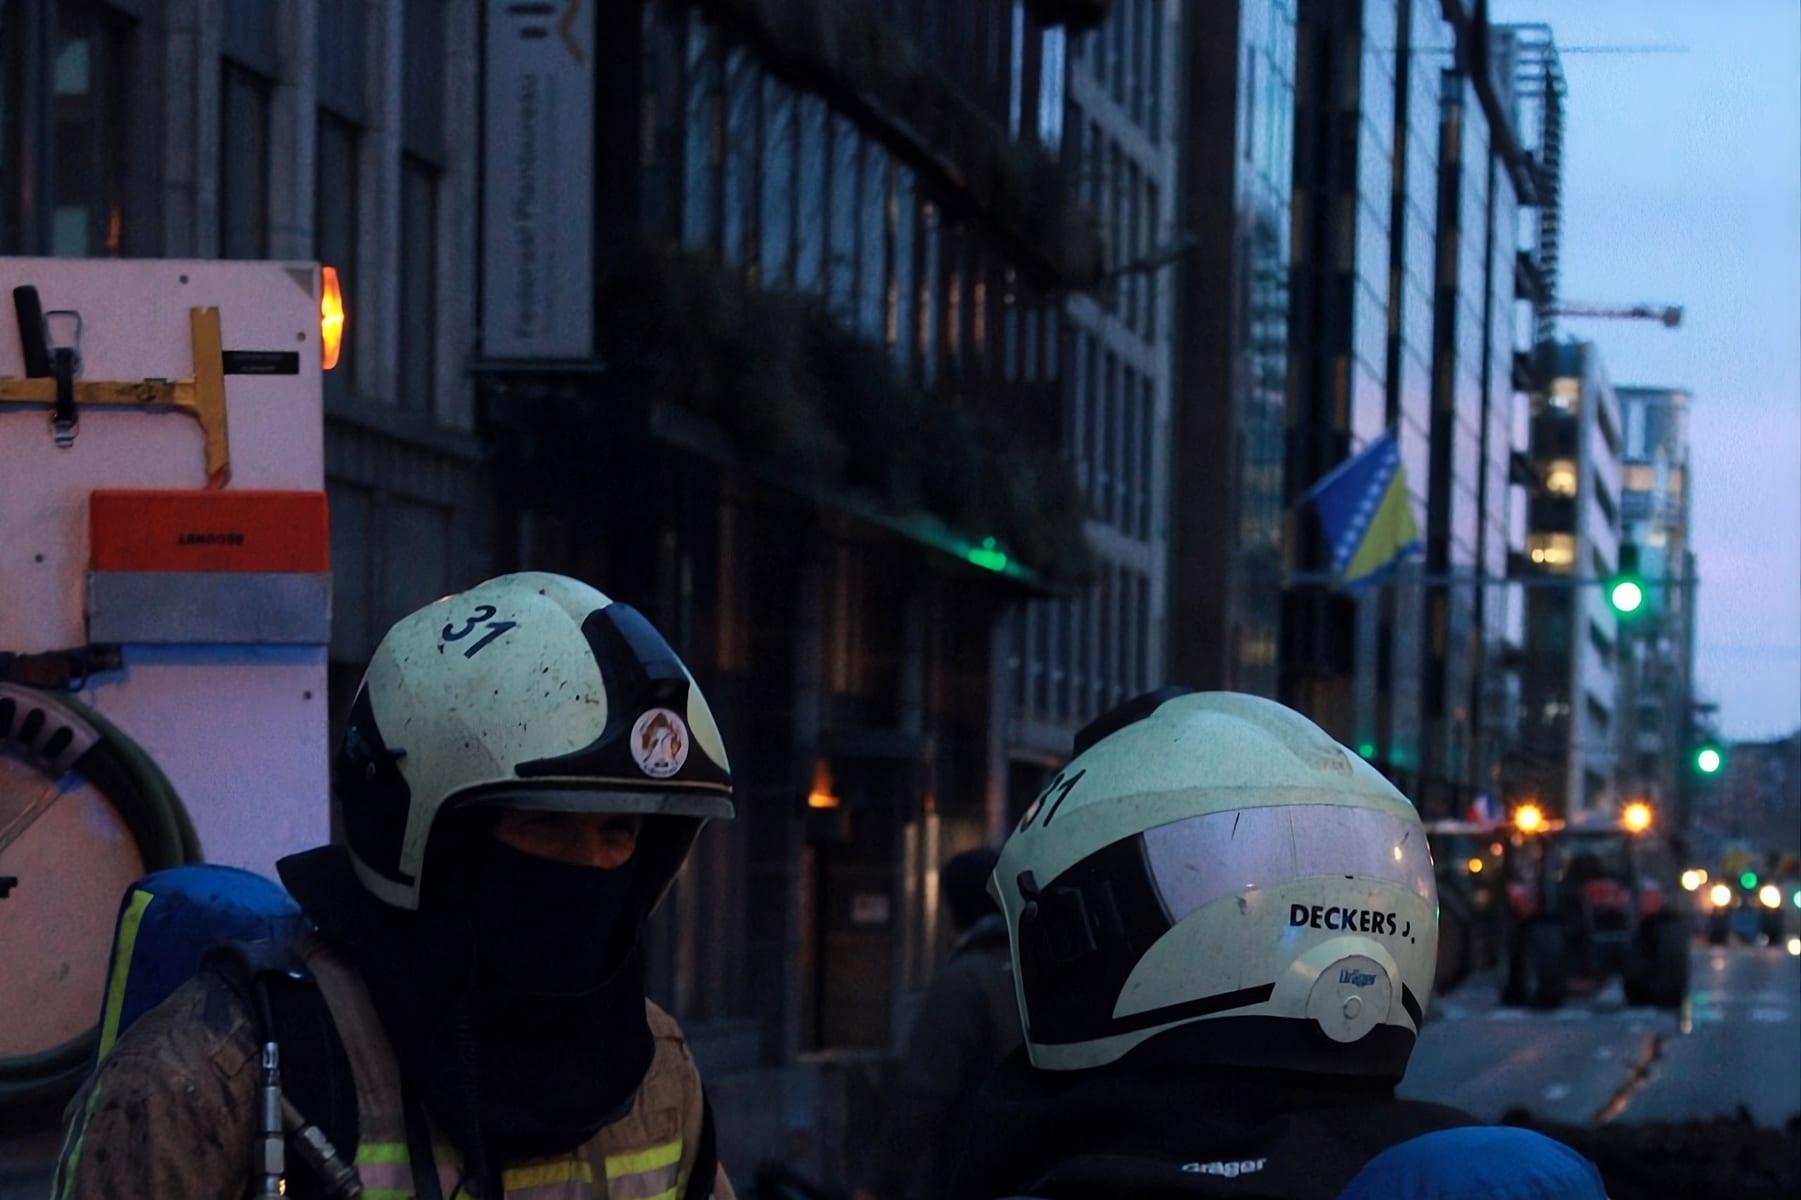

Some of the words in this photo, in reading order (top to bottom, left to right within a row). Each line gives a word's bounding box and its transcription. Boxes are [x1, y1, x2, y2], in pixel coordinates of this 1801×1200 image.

[442, 605, 517, 659] 31
[1290, 904, 1397, 935] DECKERS
[1402, 921, 1416, 944] J.
